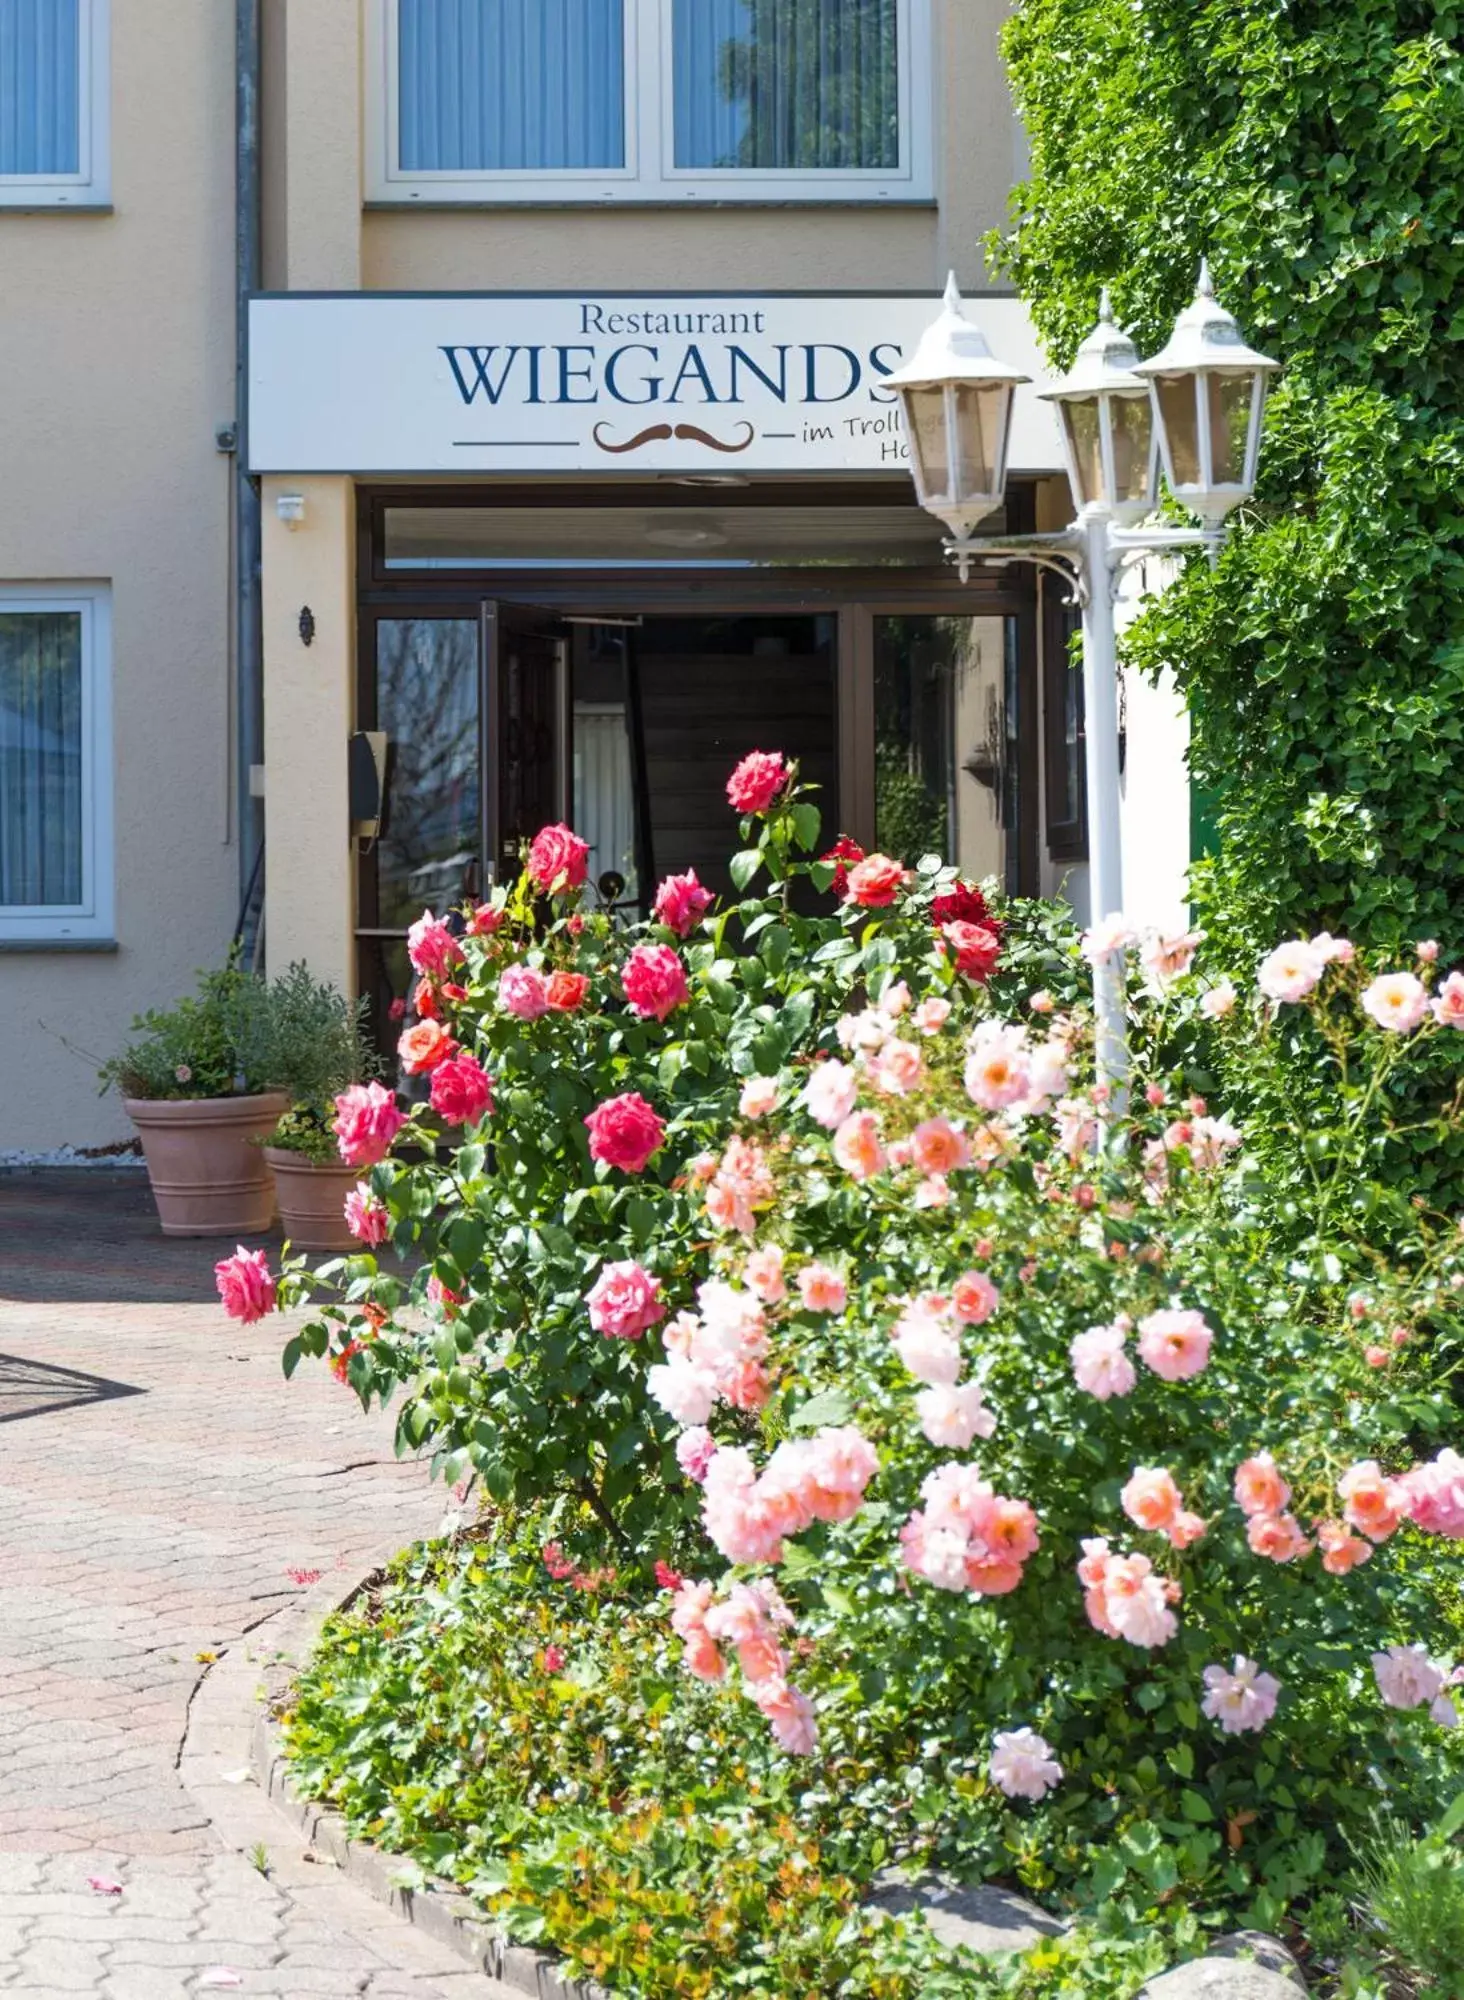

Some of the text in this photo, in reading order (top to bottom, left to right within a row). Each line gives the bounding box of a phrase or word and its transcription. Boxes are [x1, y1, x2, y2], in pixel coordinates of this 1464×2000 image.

[579, 303, 765, 334] Restaurant
[437, 343, 903, 405] WIEGANDS
[803, 422, 834, 443] im
